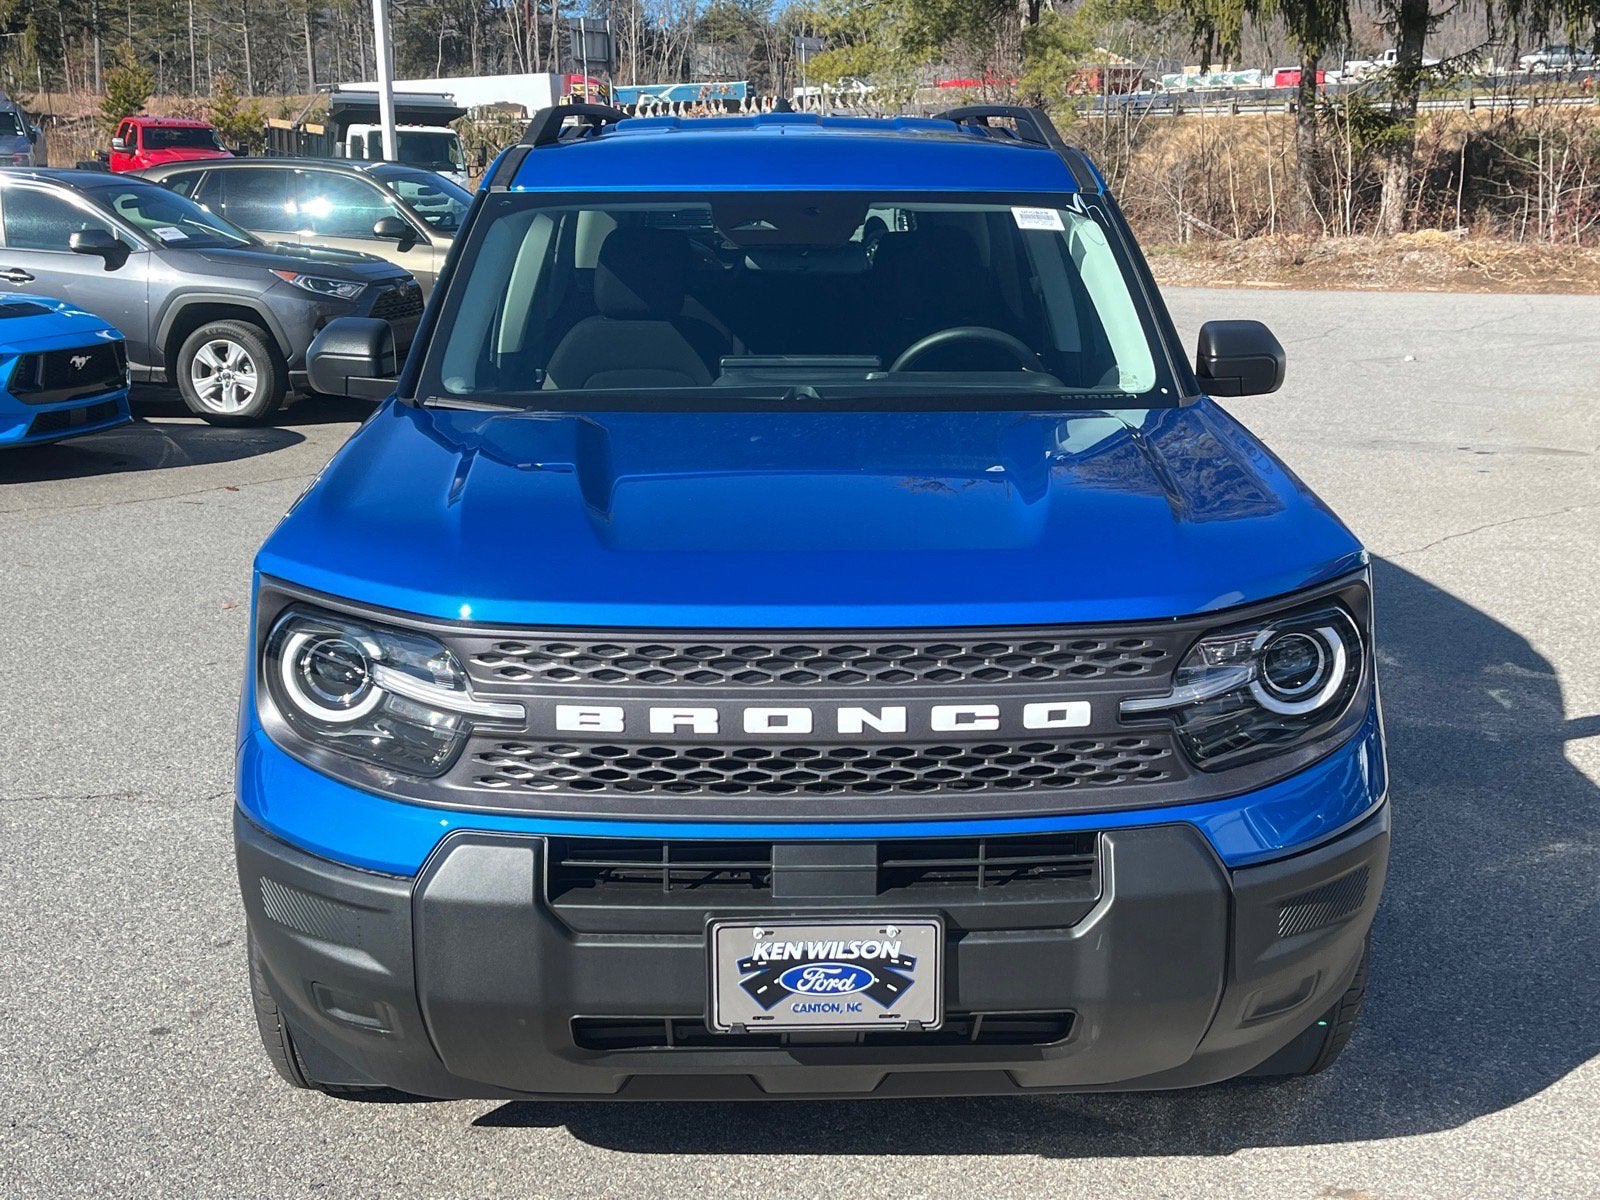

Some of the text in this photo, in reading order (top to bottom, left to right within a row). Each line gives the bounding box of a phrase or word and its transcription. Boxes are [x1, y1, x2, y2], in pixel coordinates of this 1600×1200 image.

[555, 701, 1092, 734] BRONCO
[752, 939, 901, 961] KEN WILSON
[796, 967, 856, 992] Ford
[792, 1002, 863, 1014] CANTON, NC
